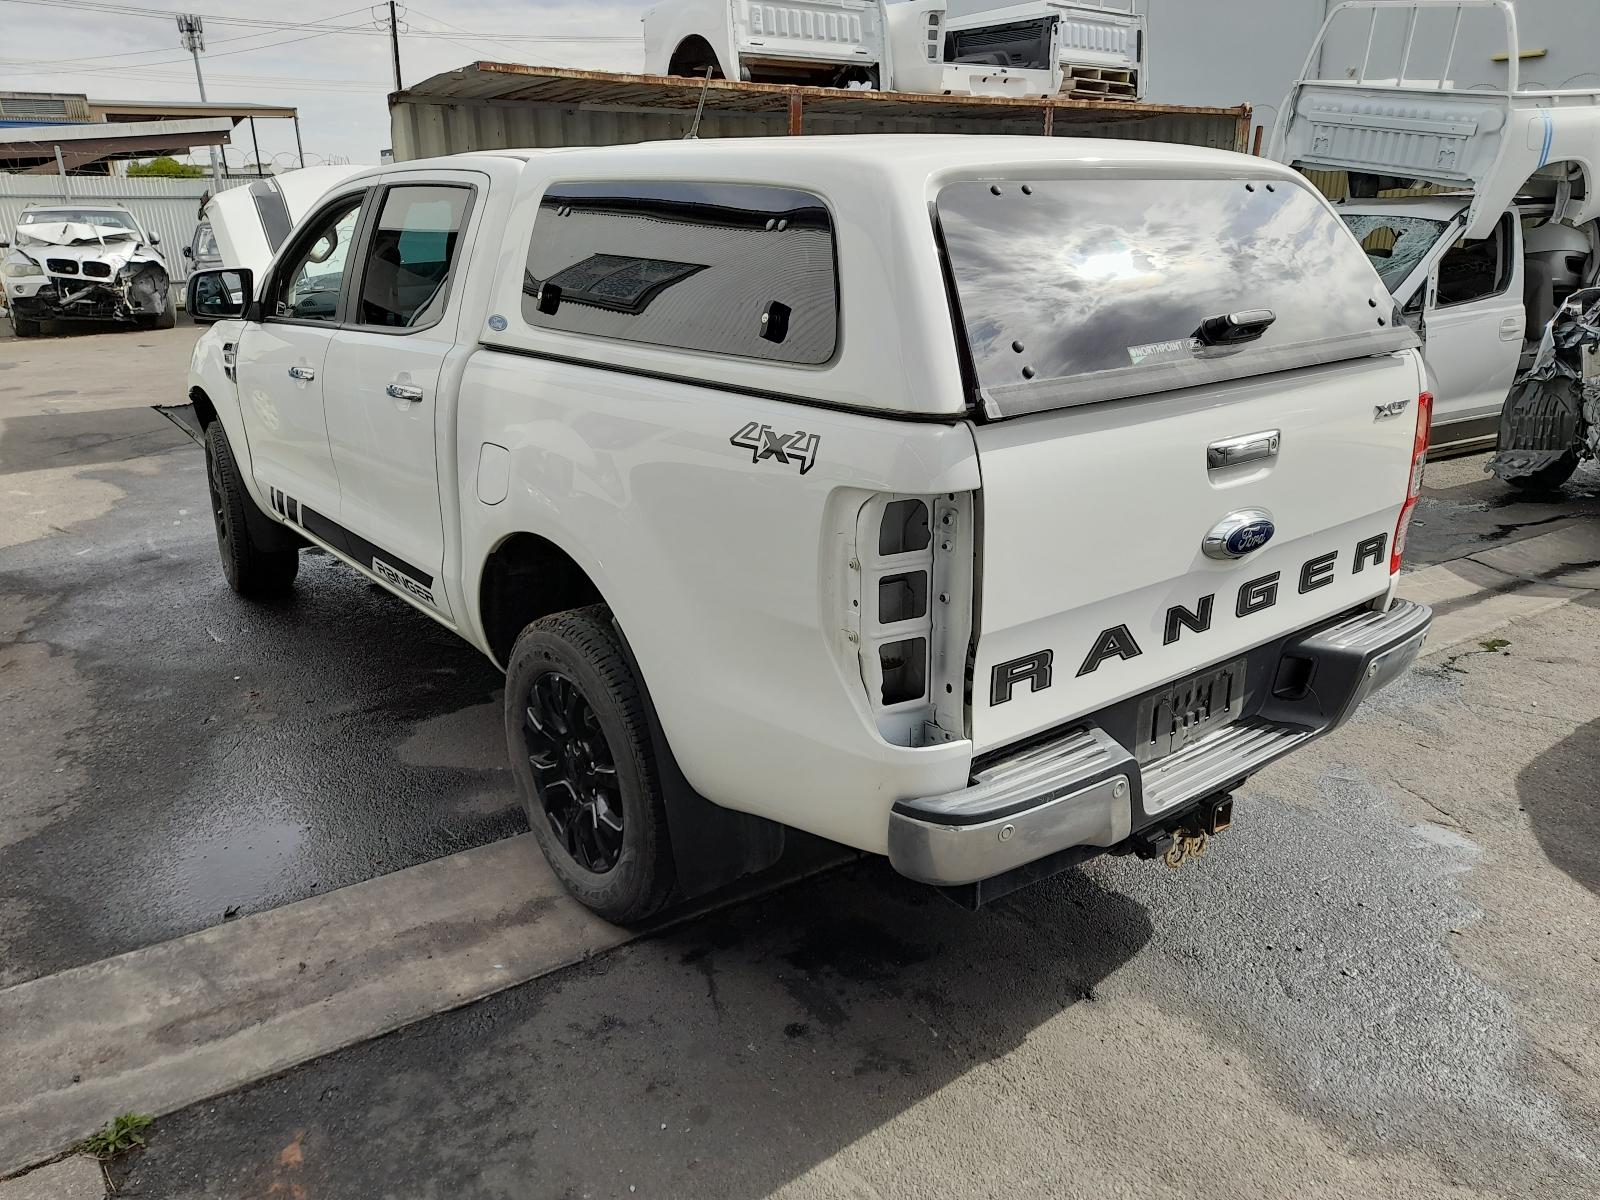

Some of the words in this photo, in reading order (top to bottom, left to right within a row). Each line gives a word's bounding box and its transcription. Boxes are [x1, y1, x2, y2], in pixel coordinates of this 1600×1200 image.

[1134, 341, 1182, 356] NORTHPOINT
[1374, 399, 1410, 418] XLT
[1238, 526, 1267, 551] Ford
[375, 560, 438, 607] RANGER
[990, 532, 1388, 707] RANGER
